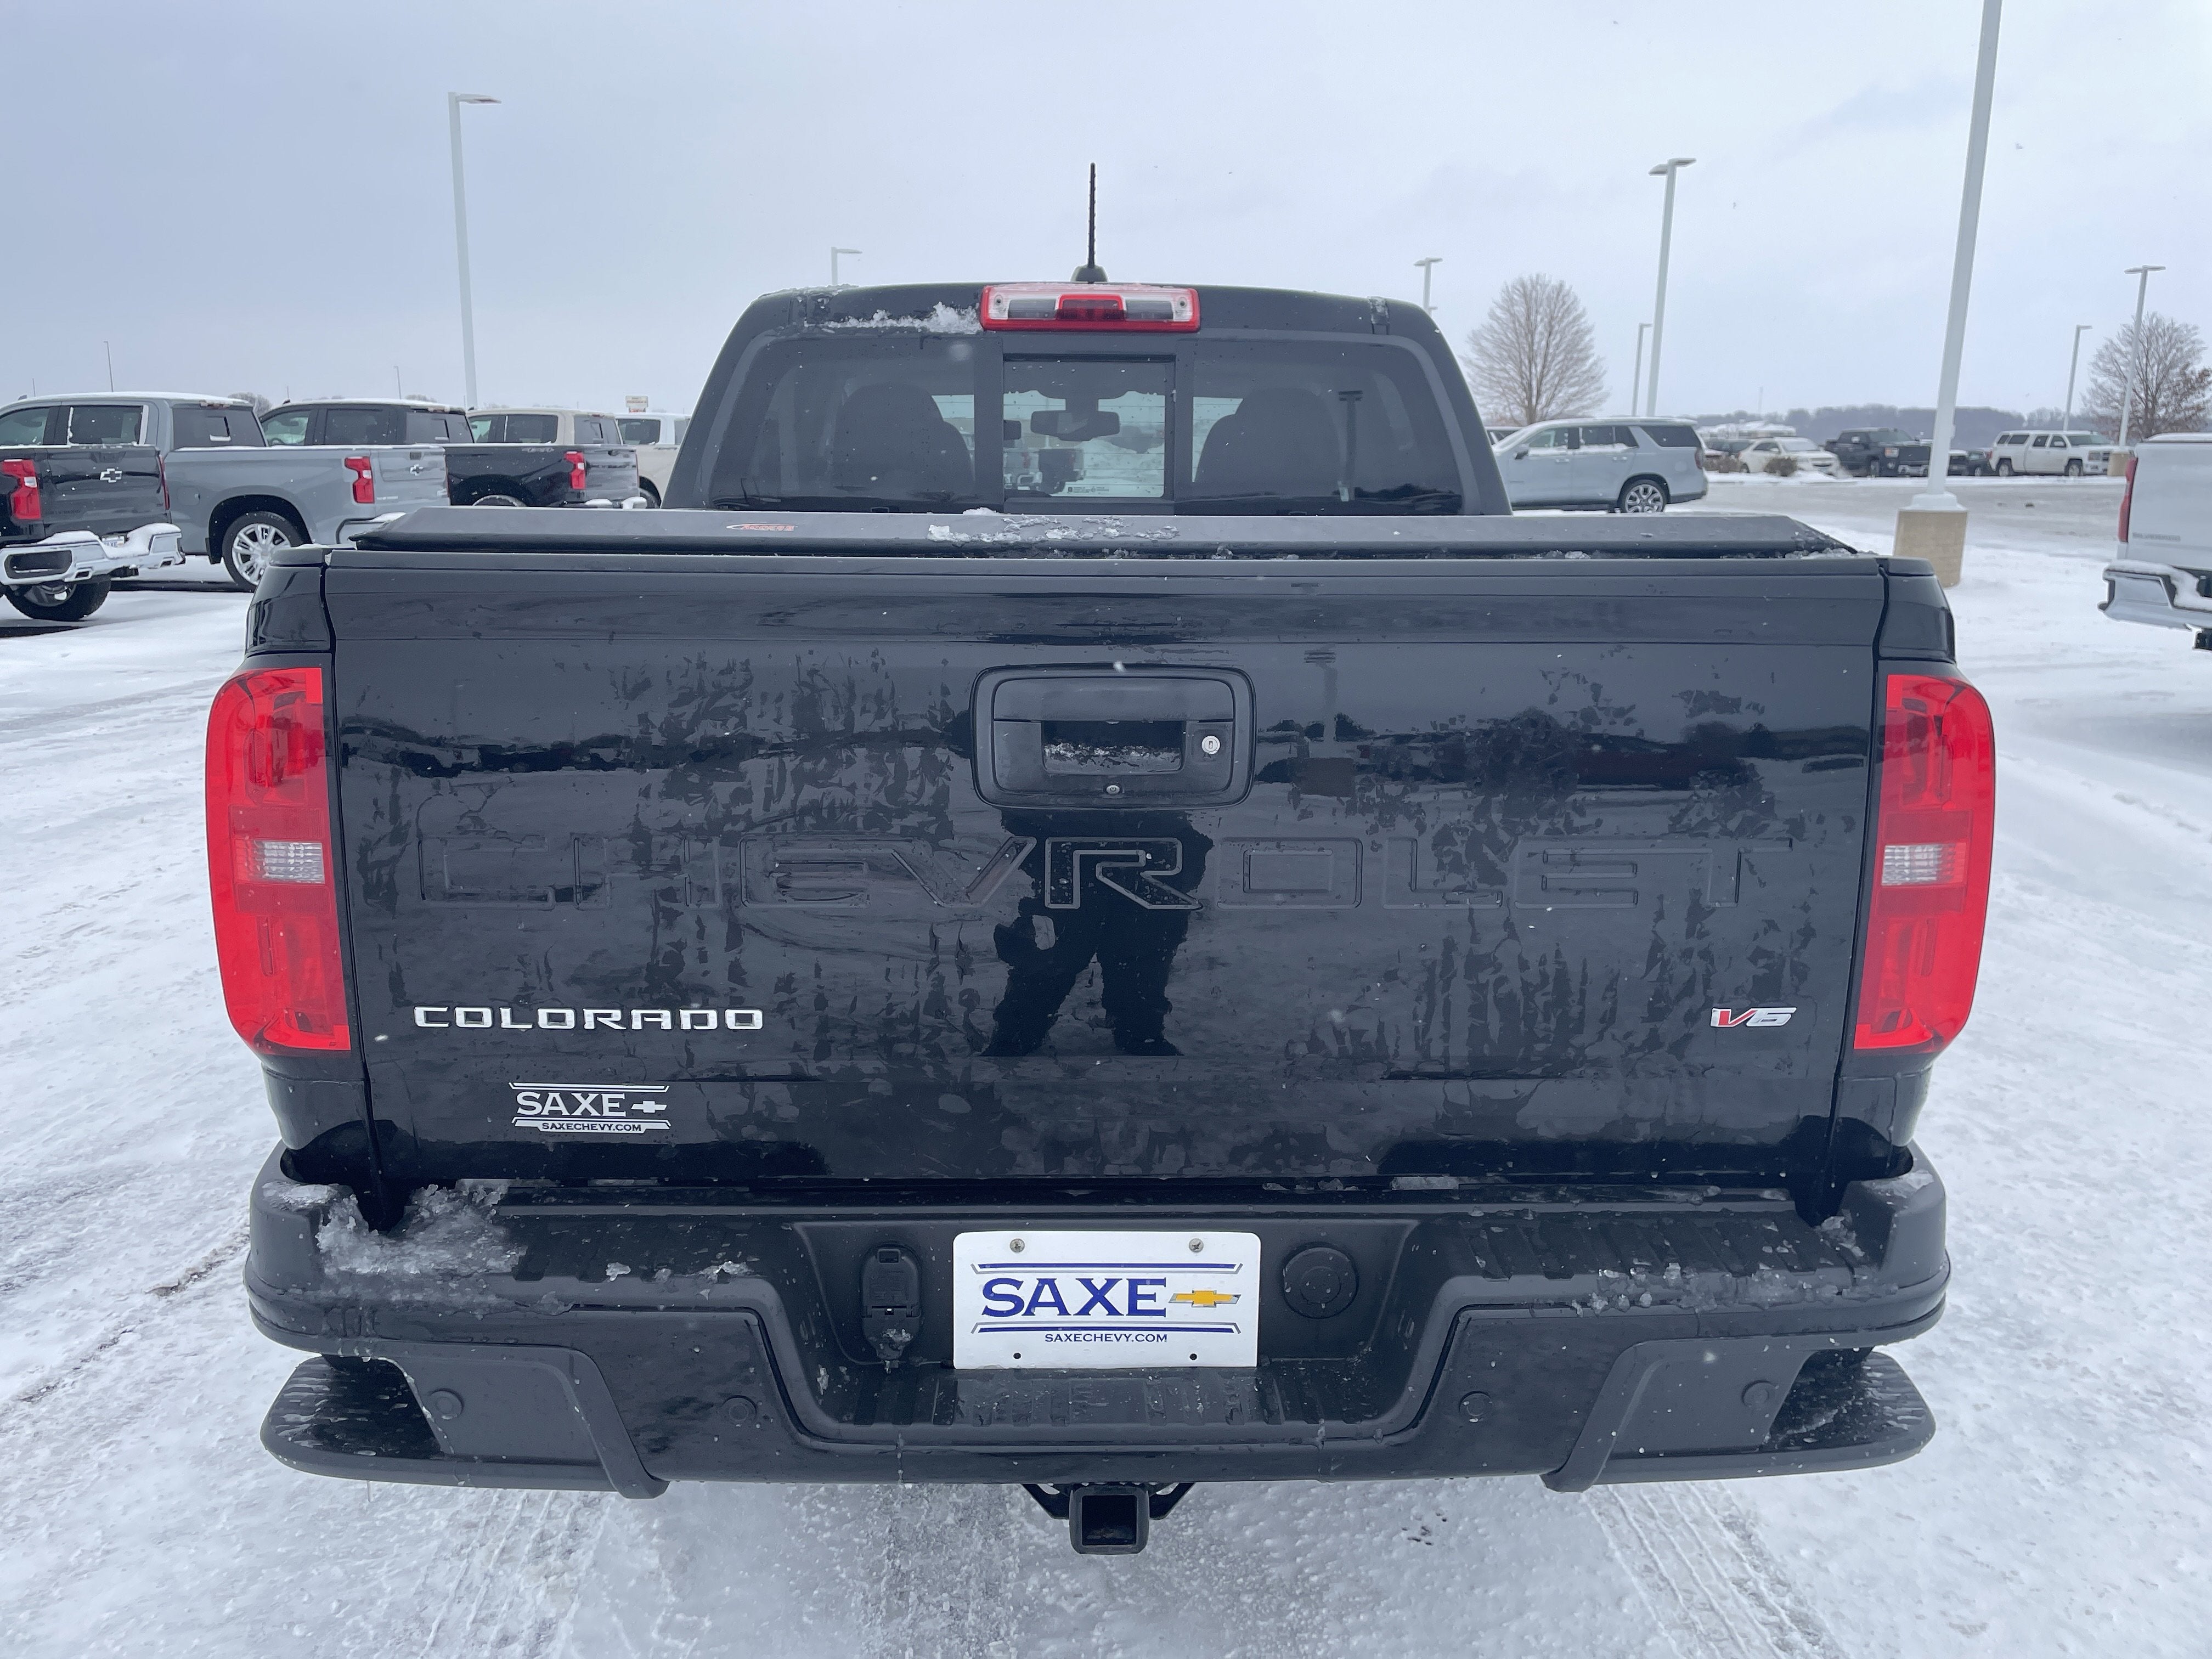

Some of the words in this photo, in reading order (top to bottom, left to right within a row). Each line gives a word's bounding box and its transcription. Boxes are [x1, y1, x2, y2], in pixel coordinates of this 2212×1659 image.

[418, 834, 1793, 910] CHEVROLET
[414, 1007, 764, 1030] COLORADO
[1710, 1007, 1797, 1028] V6
[516, 1092, 626, 1118] SAXE
[541, 1122, 642, 1132] SAXECHEVY.COM
[981, 1277, 1167, 1318] SAXE
[1044, 1333, 1168, 1343] SAXECHEVY.COM
